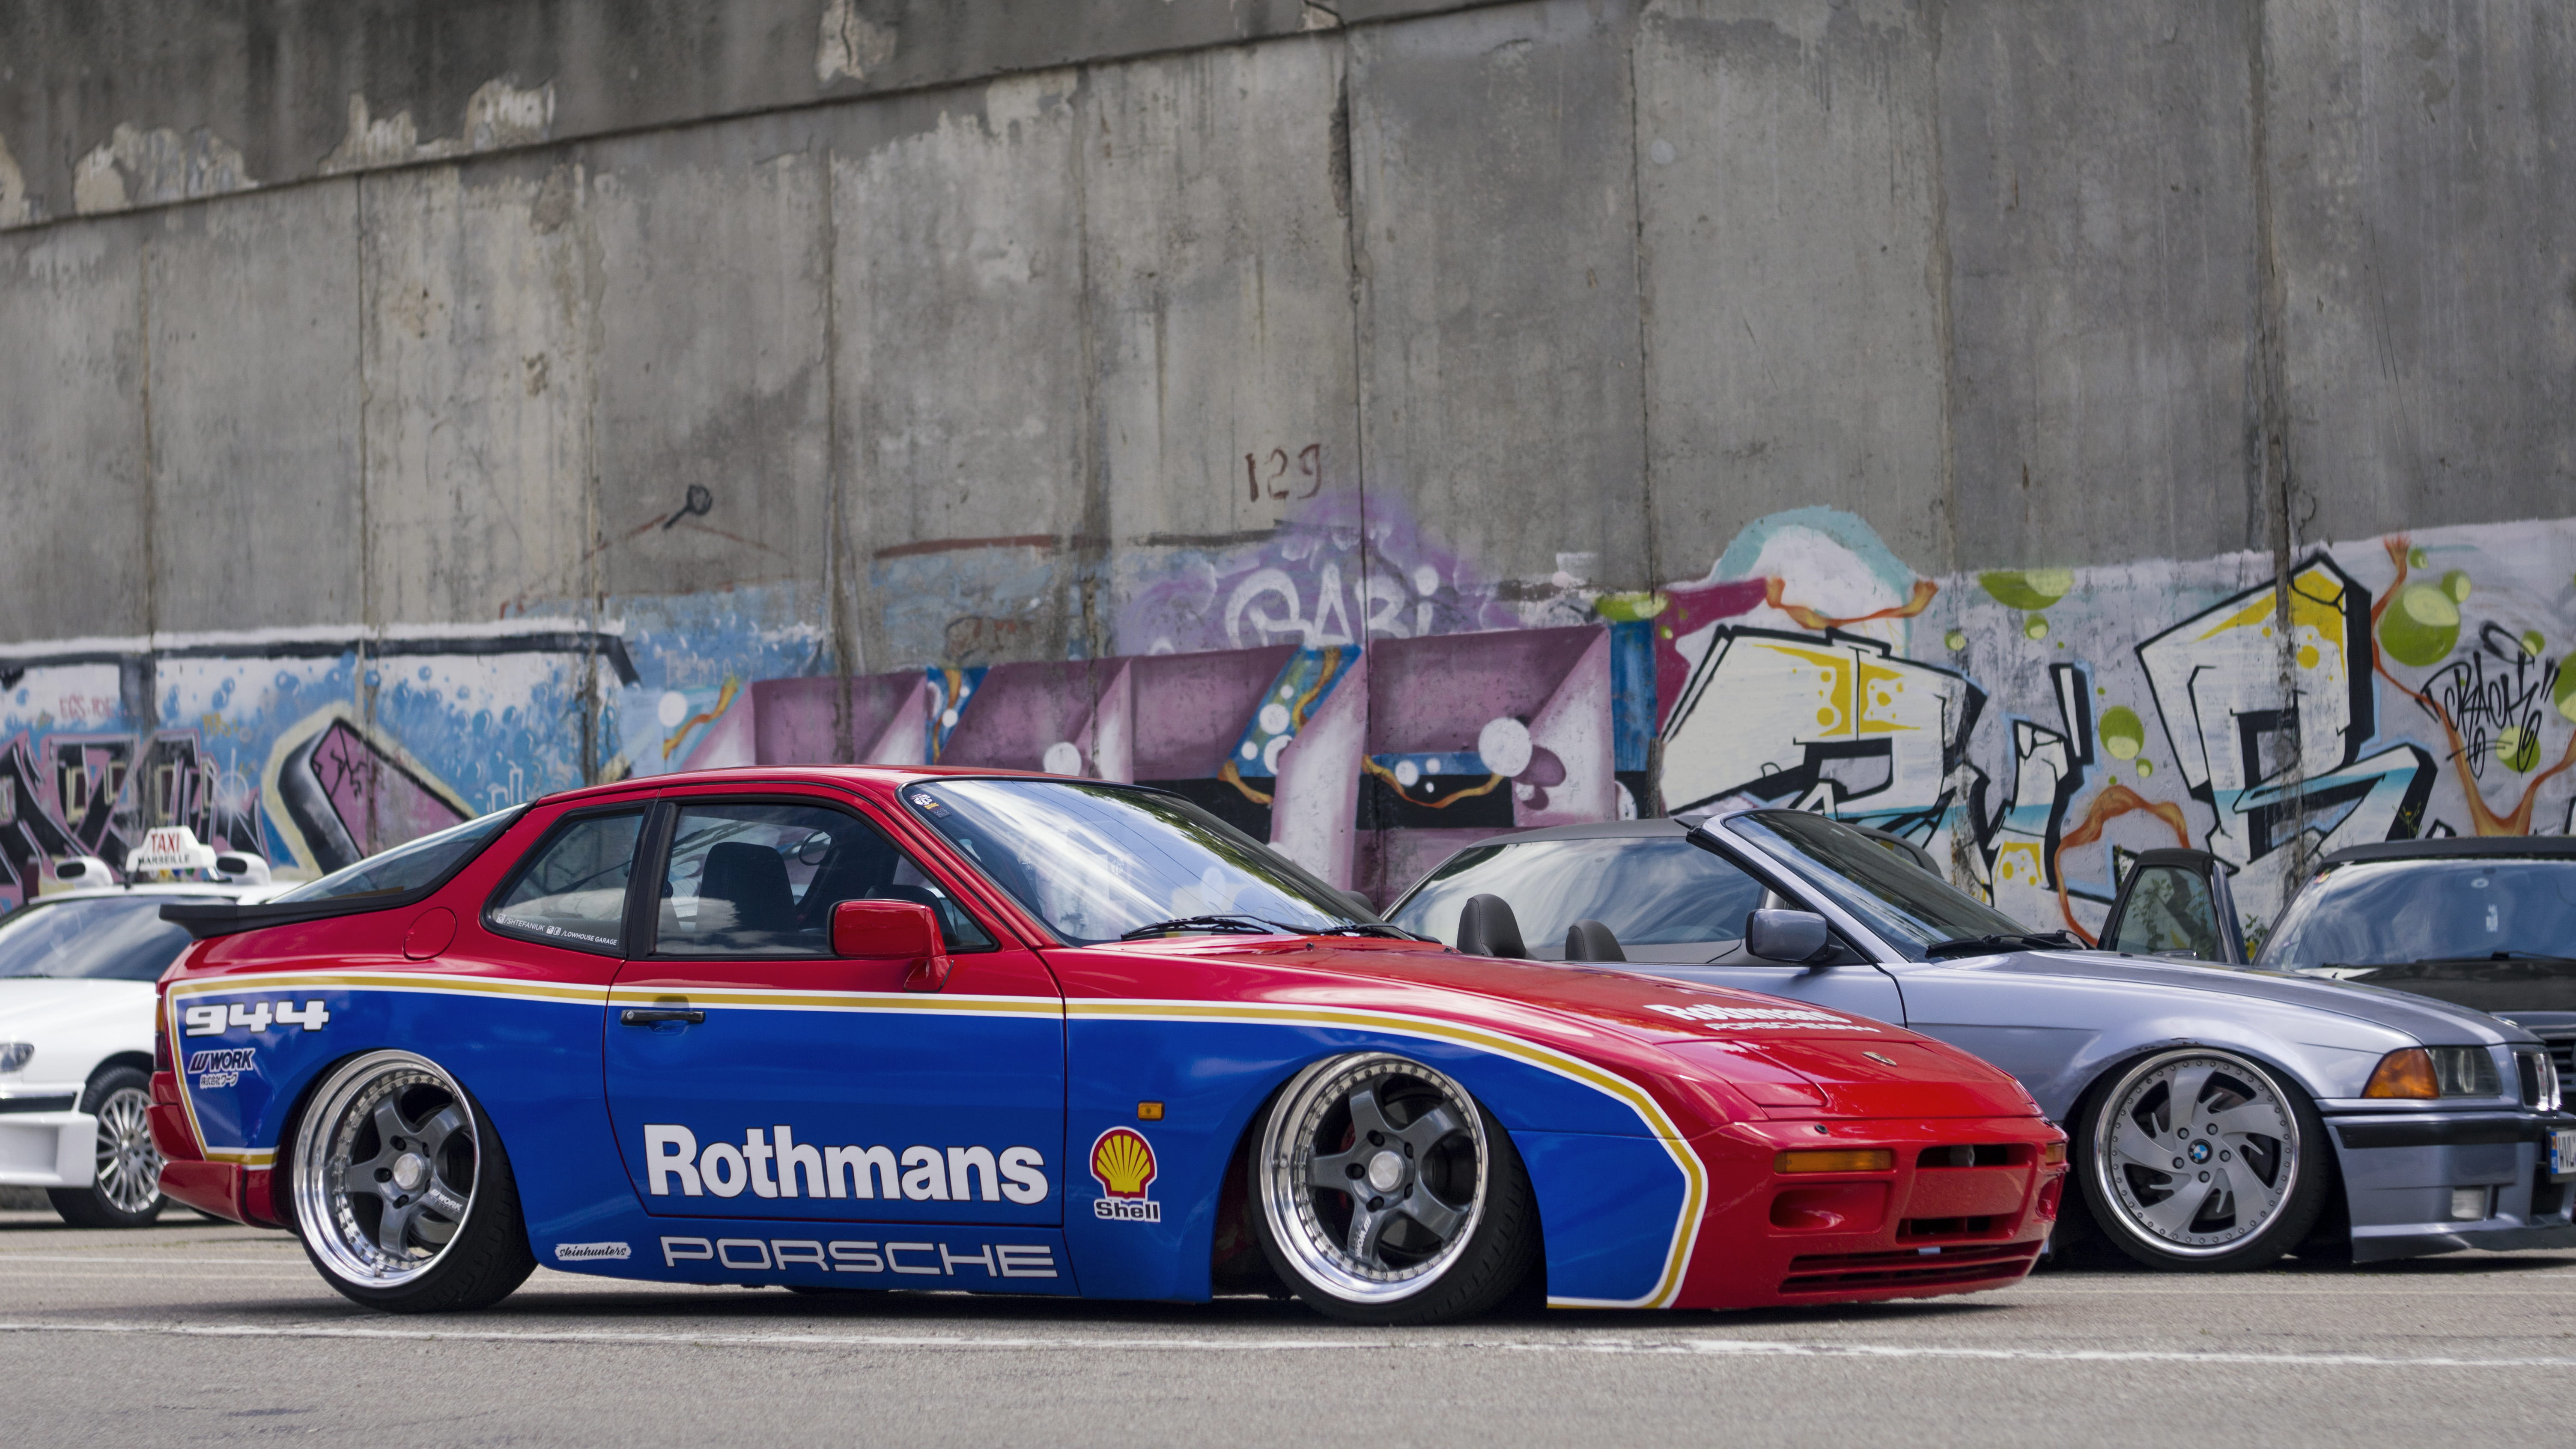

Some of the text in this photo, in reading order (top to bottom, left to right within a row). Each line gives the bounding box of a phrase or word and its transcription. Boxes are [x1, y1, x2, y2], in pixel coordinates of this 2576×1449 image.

[1245, 443, 1322, 502] 129
[151, 833, 180, 853] TAXI
[595, 936, 617, 945] GARAGE
[185, 999, 330, 1037] 944
[1643, 1004, 1853, 1023] Rothmans
[1704, 1022, 1827, 1032] PORSCHE
[210, 1049, 255, 1071] WORK
[643, 1124, 1049, 1205] Rothmans
[438, 1193, 462, 1211] WORK
[1095, 1201, 1159, 1220] Shell
[559, 1245, 626, 1257] skinhunters
[1356, 1229, 1367, 1260] WORK
[659, 1236, 1058, 1278] PORSCHE
